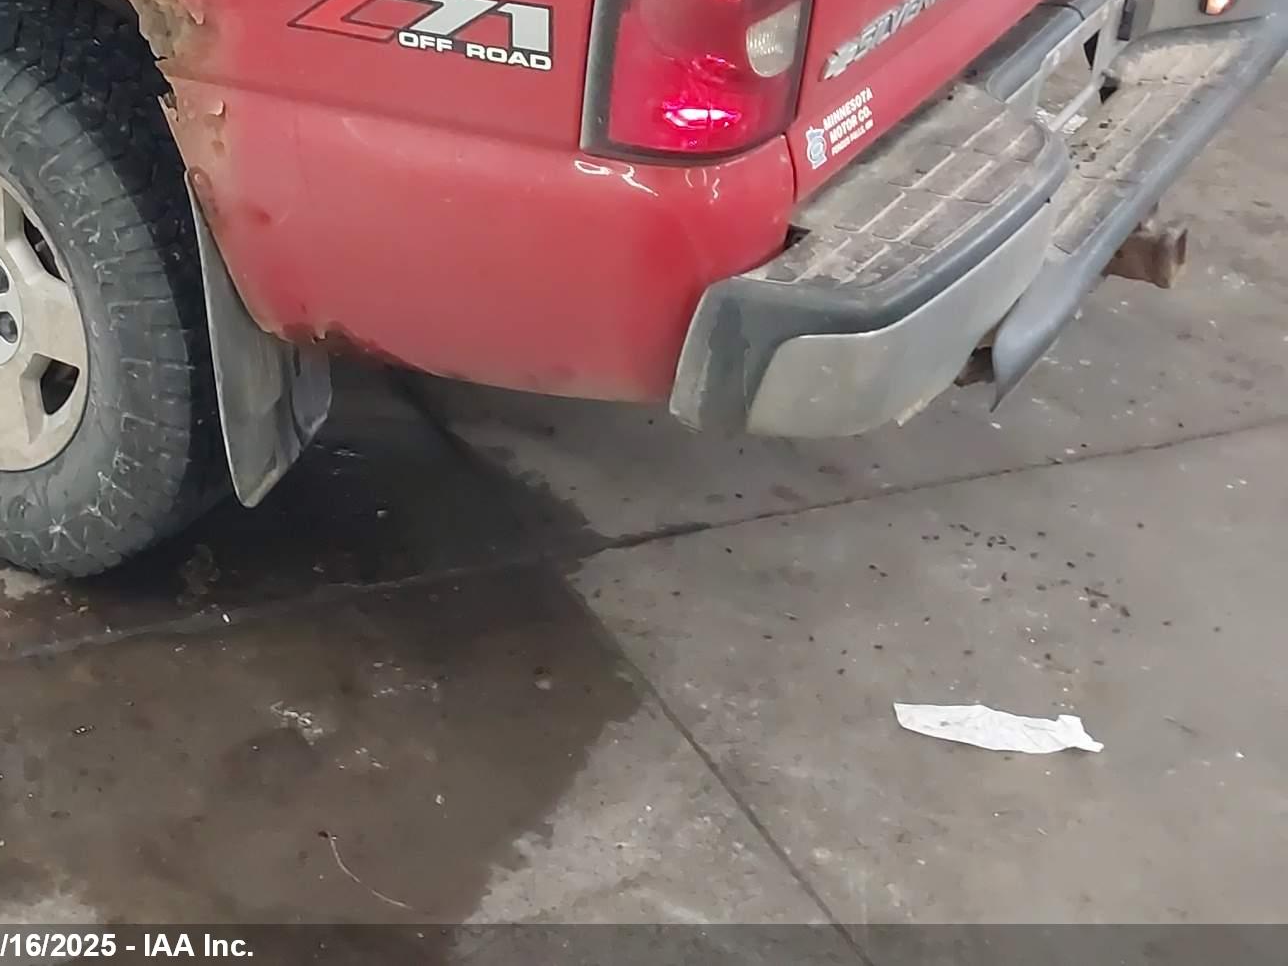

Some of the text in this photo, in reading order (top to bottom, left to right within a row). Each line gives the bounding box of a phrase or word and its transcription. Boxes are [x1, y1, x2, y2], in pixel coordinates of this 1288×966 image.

[398, 31, 553, 71] OFF ROAD
[823, 86, 874, 131] MINNESOTA
[829, 114, 858, 144] MOTOR
